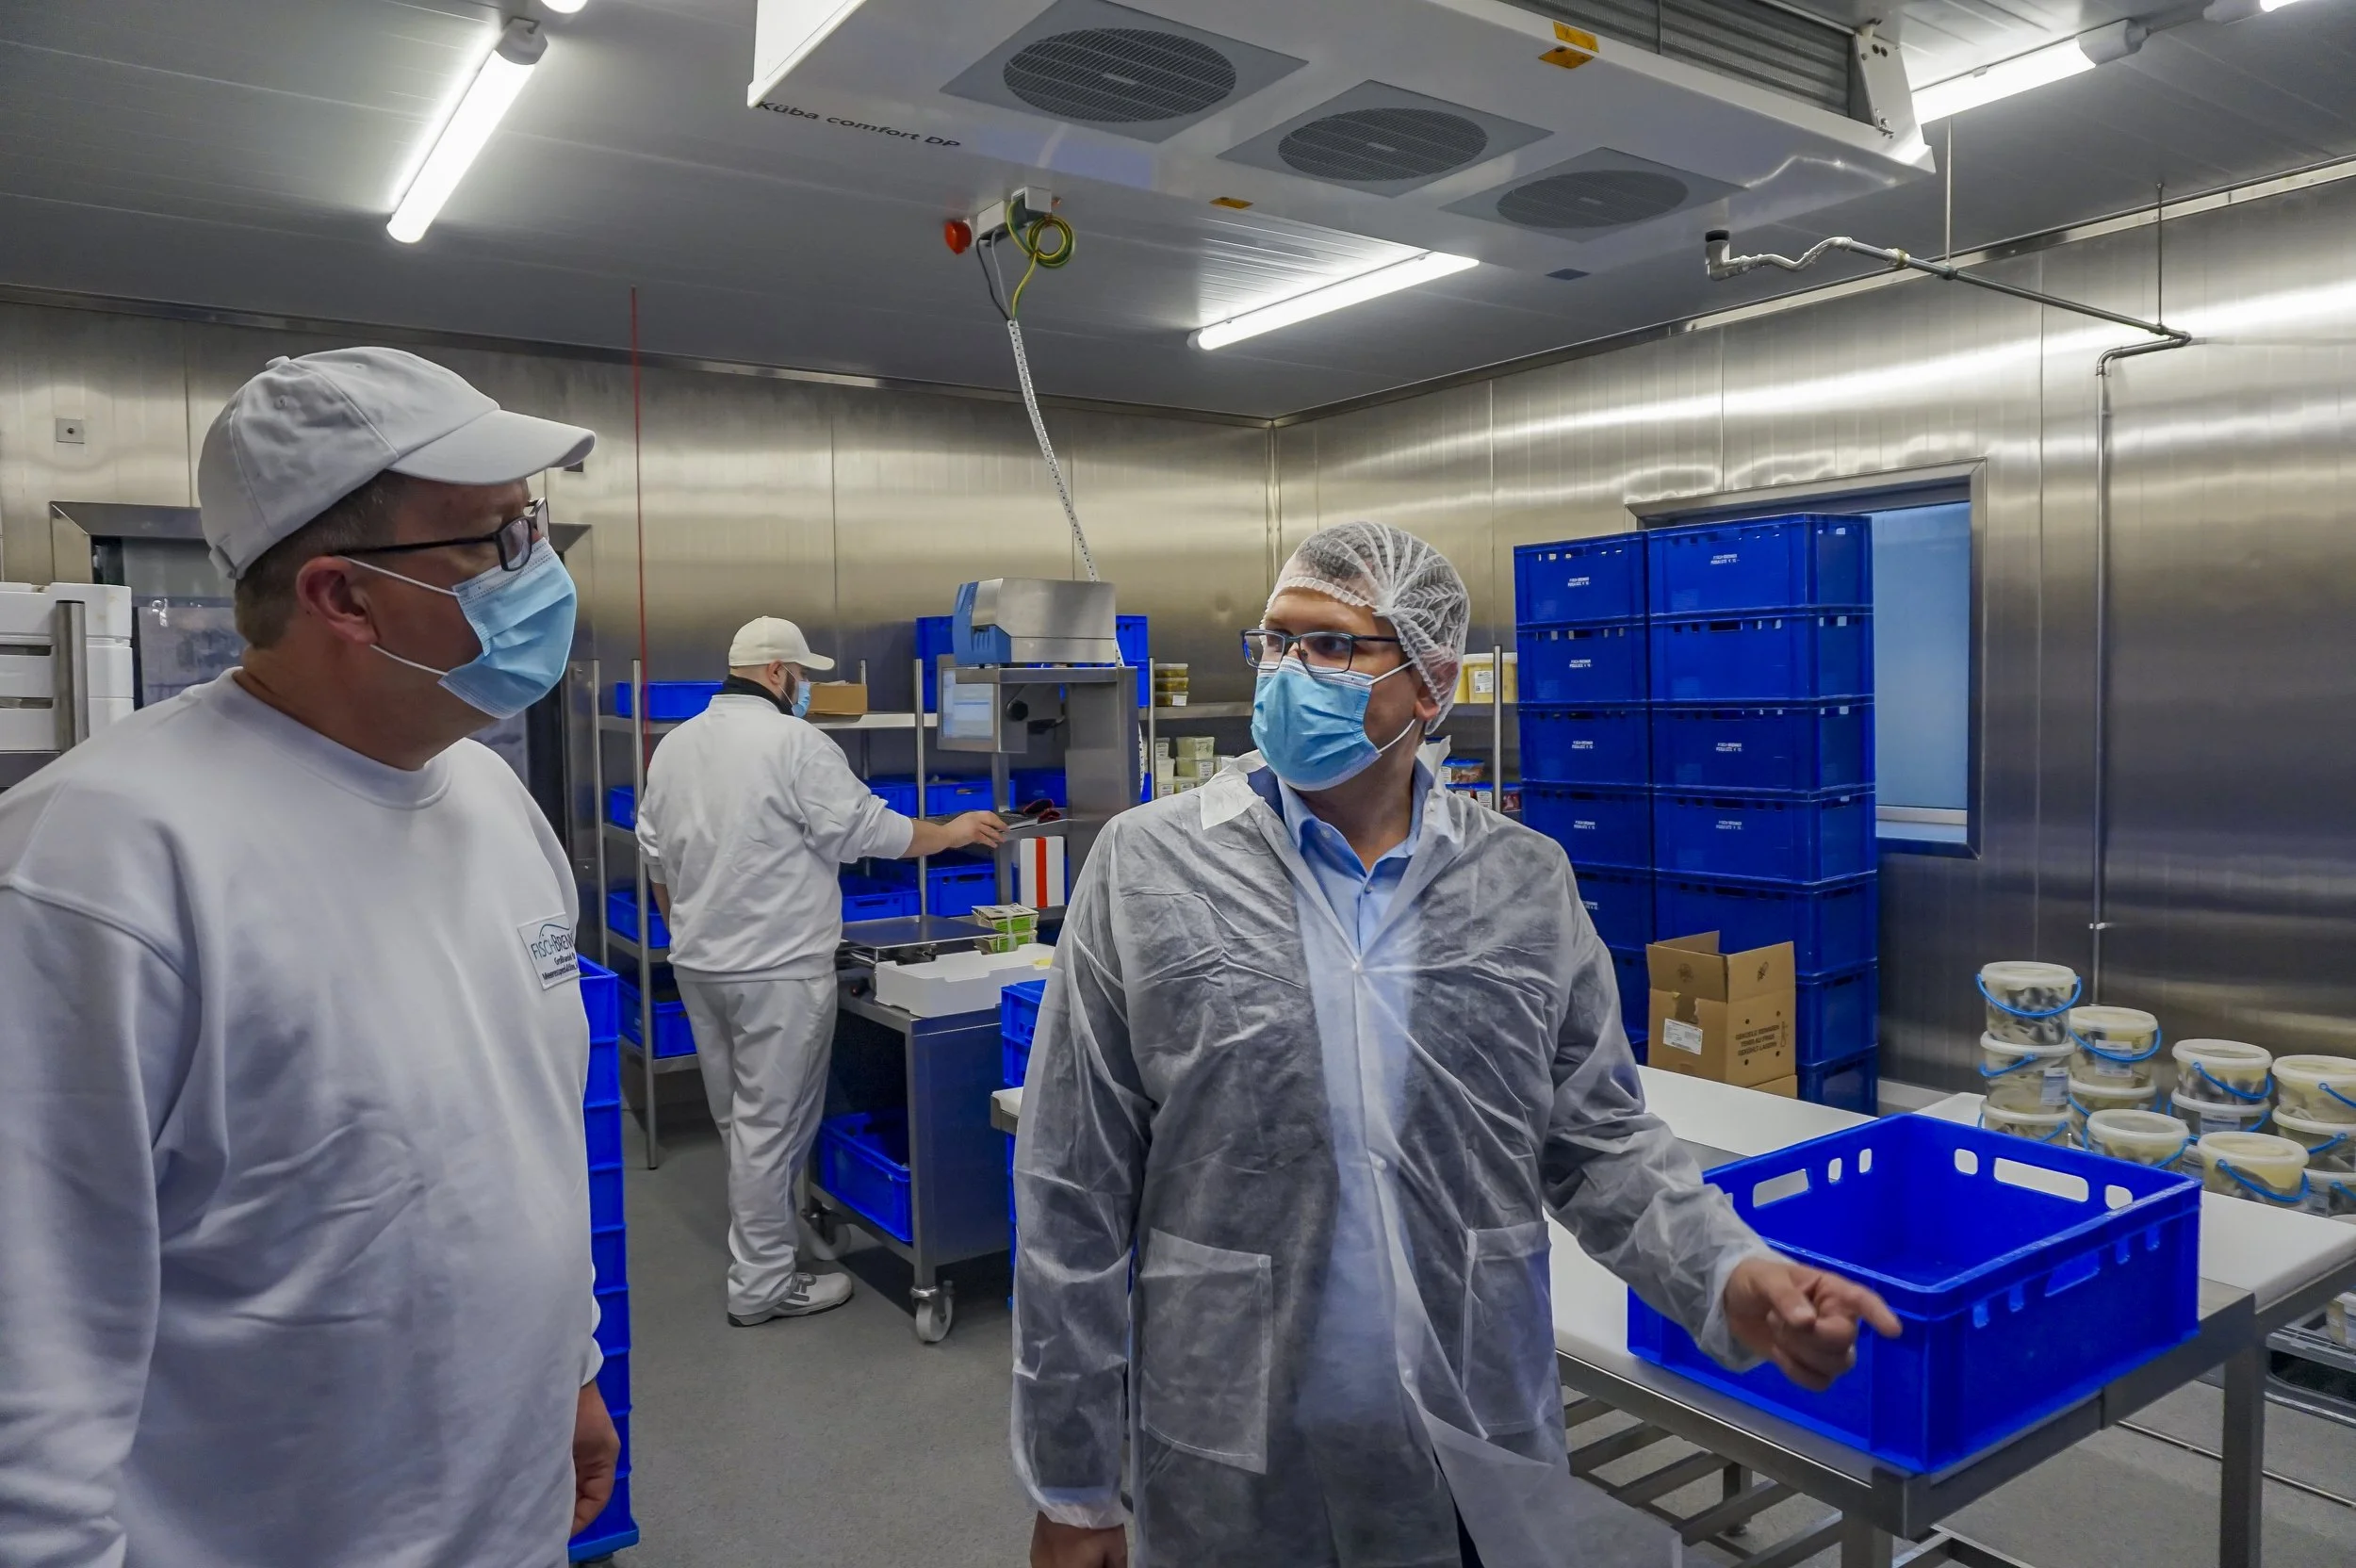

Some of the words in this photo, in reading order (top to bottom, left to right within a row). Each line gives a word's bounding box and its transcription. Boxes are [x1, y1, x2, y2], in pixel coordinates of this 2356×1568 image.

[755, 101, 819, 120] Küba
[826, 117, 921, 140] comfort
[924, 136, 960, 147] DP
